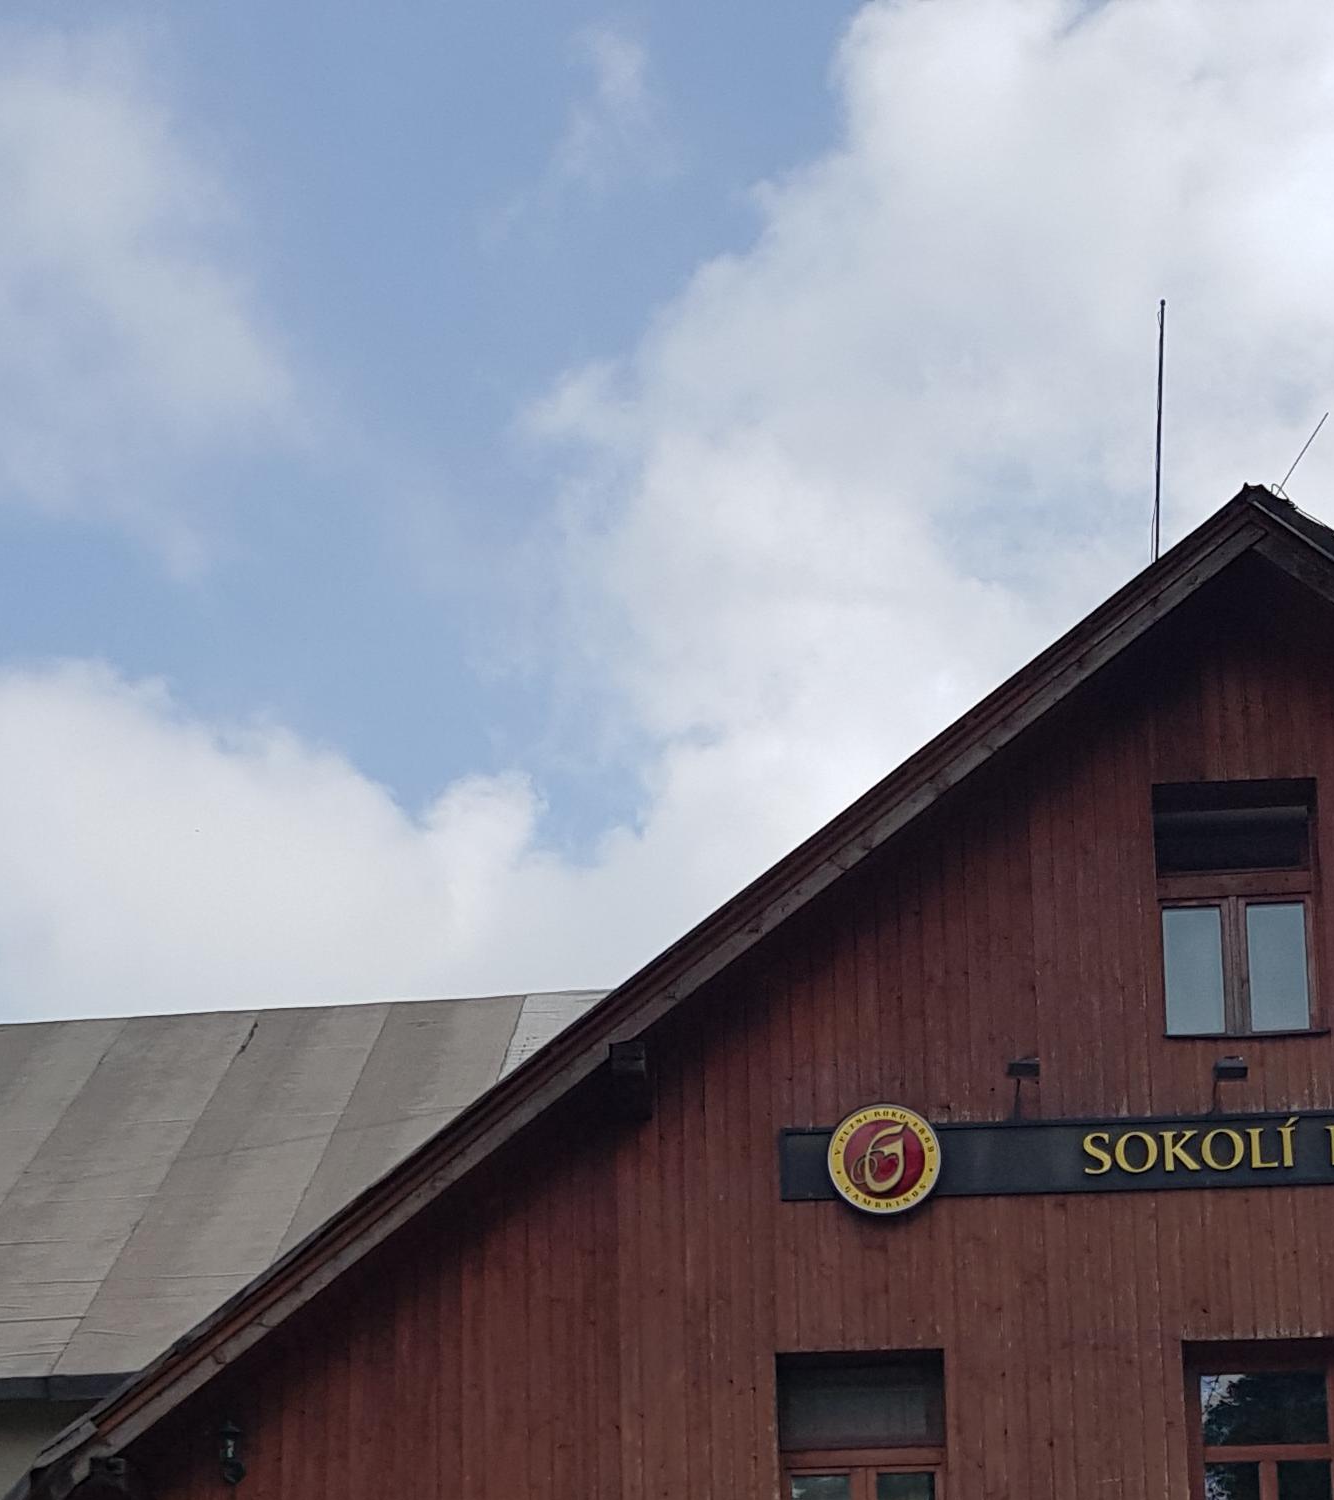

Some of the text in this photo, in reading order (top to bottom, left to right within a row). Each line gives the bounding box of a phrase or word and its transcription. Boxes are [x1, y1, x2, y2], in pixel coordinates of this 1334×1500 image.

[873, 1110, 907, 1120] ROKU
[1082, 1115, 1300, 1175] SOKOLÍ
[844, 1183, 927, 1209] GAMBRINUS
